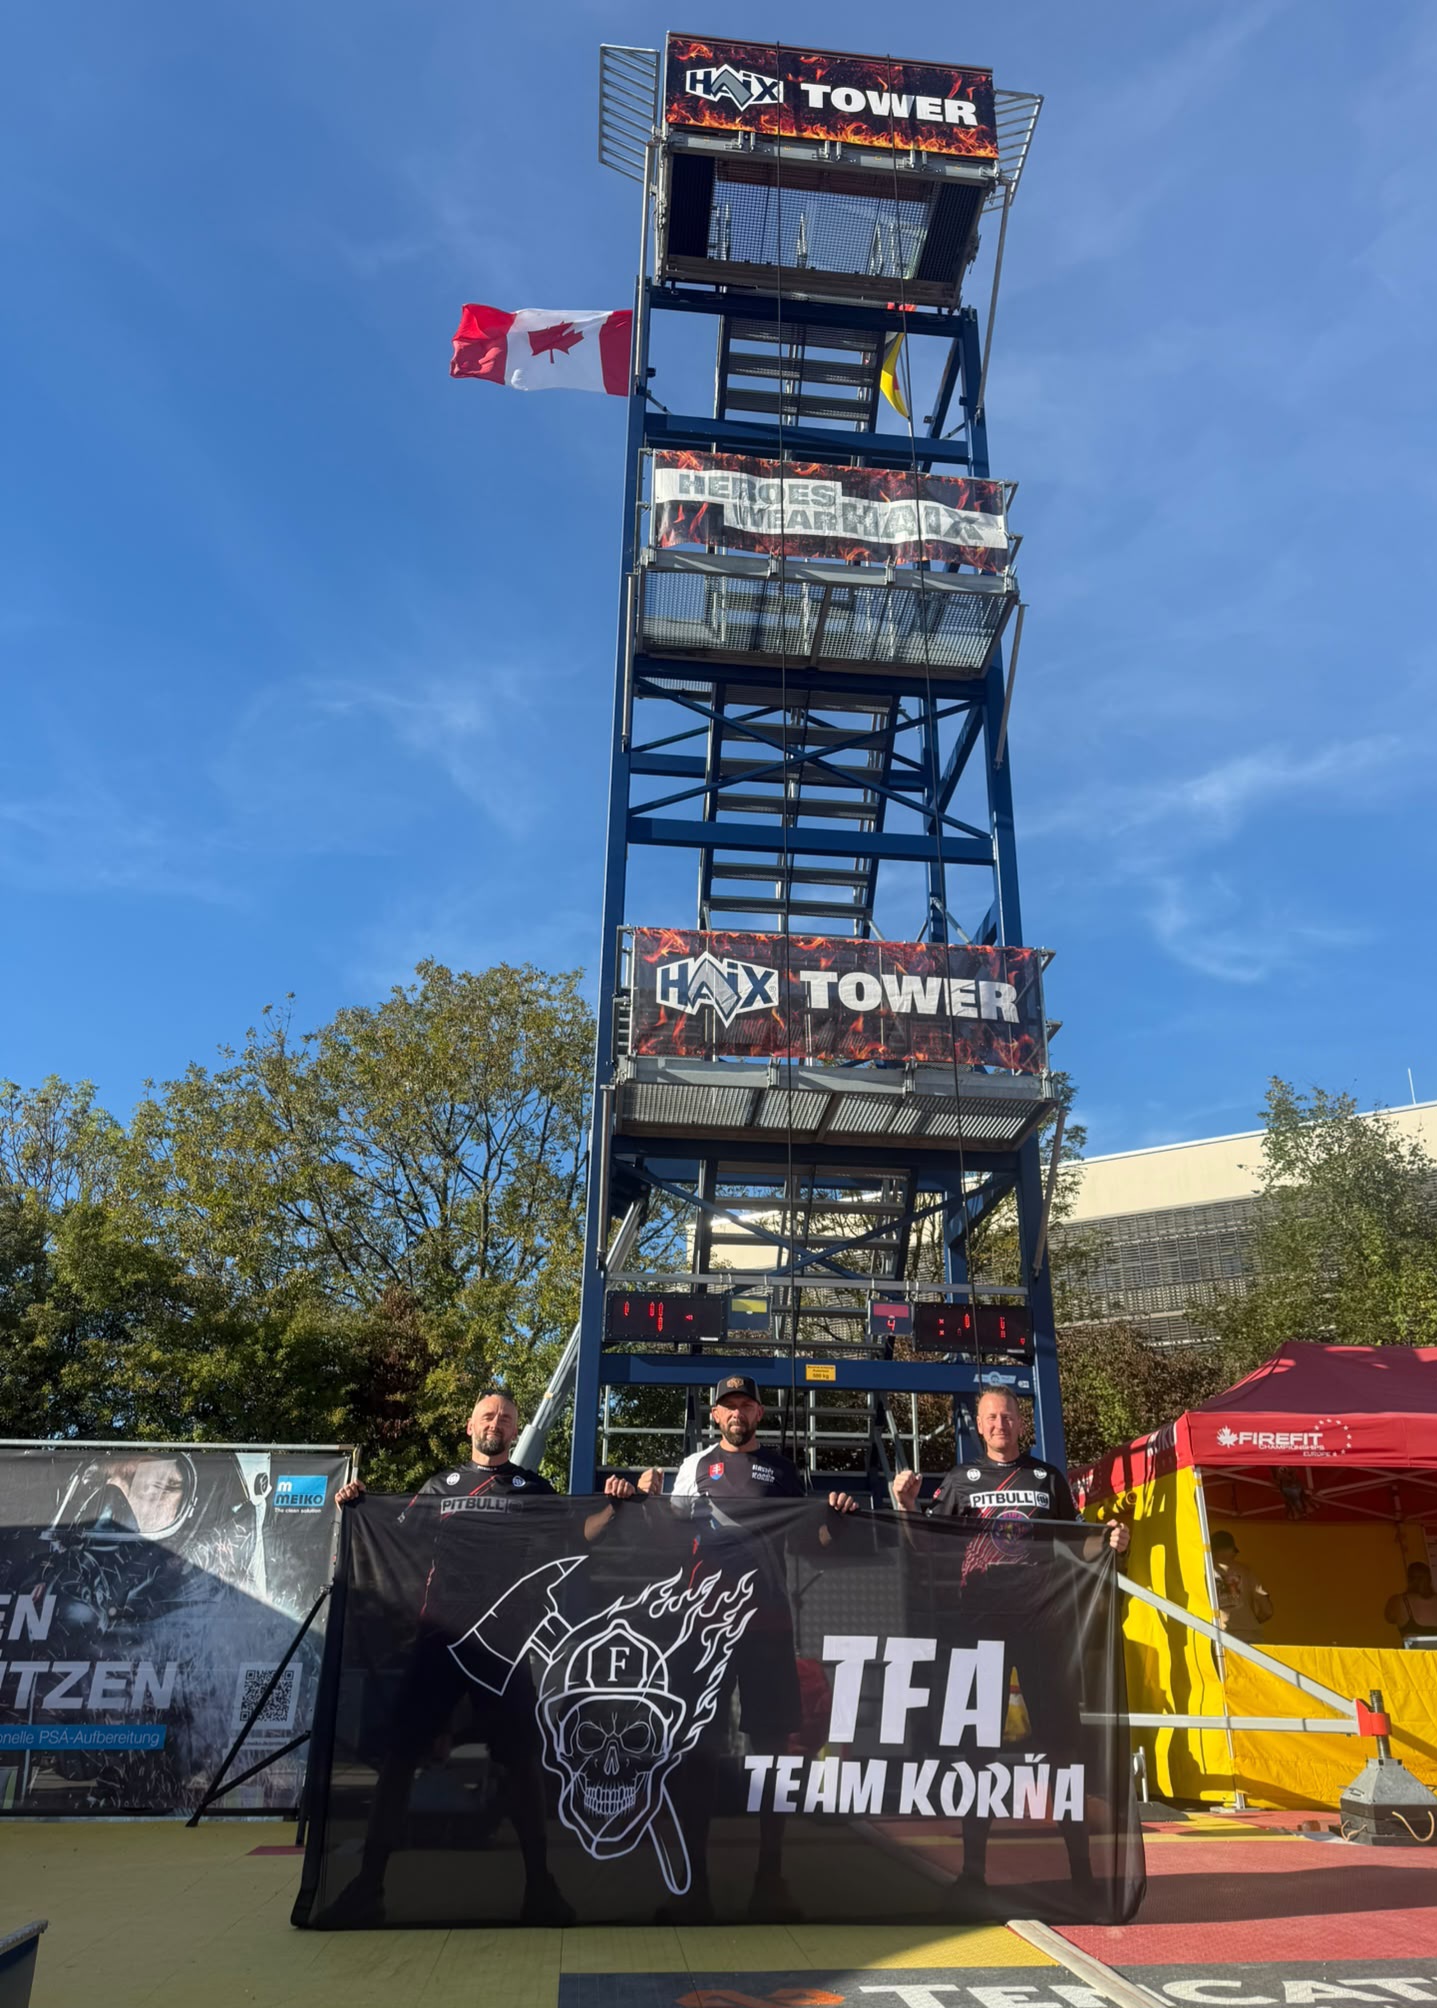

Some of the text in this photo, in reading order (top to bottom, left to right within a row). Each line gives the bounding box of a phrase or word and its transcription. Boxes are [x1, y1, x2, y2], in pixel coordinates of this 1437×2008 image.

[801, 83, 978, 126] TOWER
[679, 474, 836, 507] HEROES
[732, 502, 985, 541] WEAR HAIX
[800, 969, 1020, 1024] TOWER
[1238, 1431, 1323, 1445] FIREFIT
[275, 1494, 323, 1504] MEIKO
[442, 1498, 504, 1511] PITBULL
[972, 1492, 1033, 1506] PITBULL
[0, 1594, 57, 1640] N
[607, 1647, 629, 1681] F
[0, 1661, 178, 1709] TZEN
[822, 1635, 1005, 1747] TFA
[39, 1730, 160, 1747] PSA-Aufbereitung
[744, 1753, 1084, 1822] TEAM KORŇA
